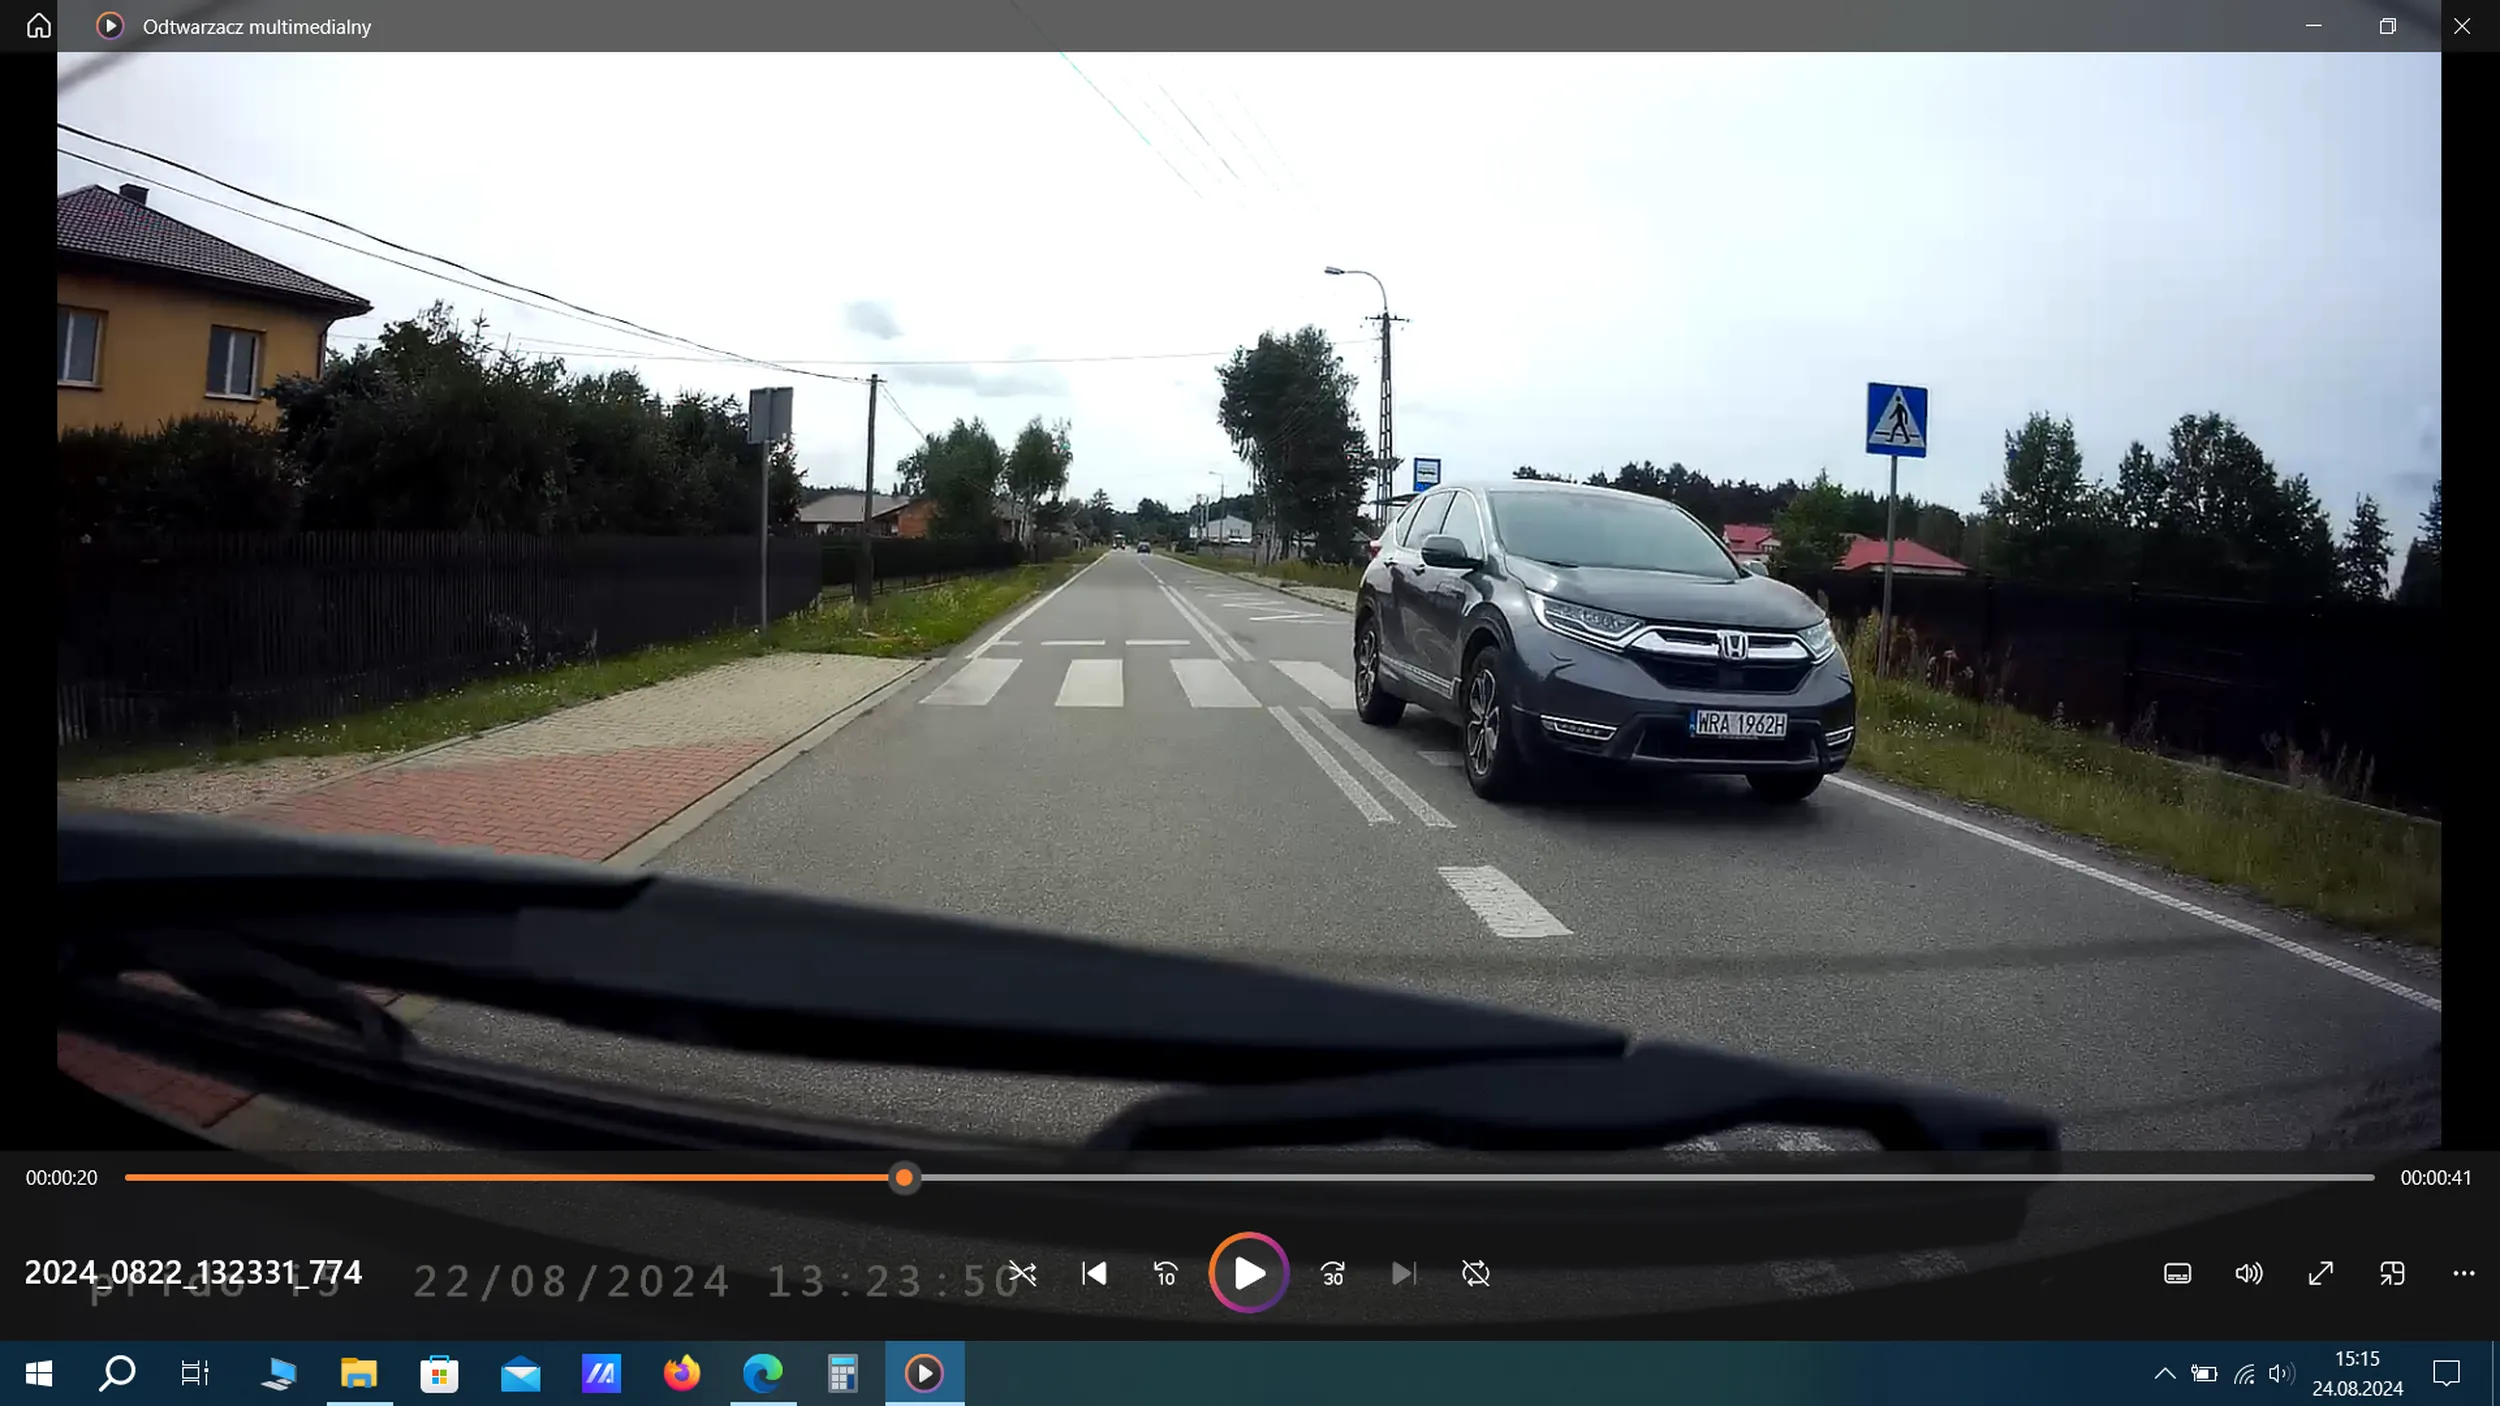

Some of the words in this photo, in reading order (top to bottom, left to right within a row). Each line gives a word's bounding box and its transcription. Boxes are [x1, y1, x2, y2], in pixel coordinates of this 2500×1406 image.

[143, 18, 244, 35] Odtwarzacz
[249, 18, 372, 39] multimedialny
[1699, 712, 1730, 734] WRA
[1739, 714, 1786, 736] 1962H
[26, 1169, 98, 1186] 00:00:20
[2400, 1169, 2471, 1186] 00:00:41
[25, 1259, 363, 1290] 2024_0822_132331_774
[1158, 1272, 1176, 1286] 10
[1323, 1272, 1344, 1286] 30
[2335, 1350, 2380, 1367] 15:15
[2312, 1380, 2405, 1397] 24.08.2024
